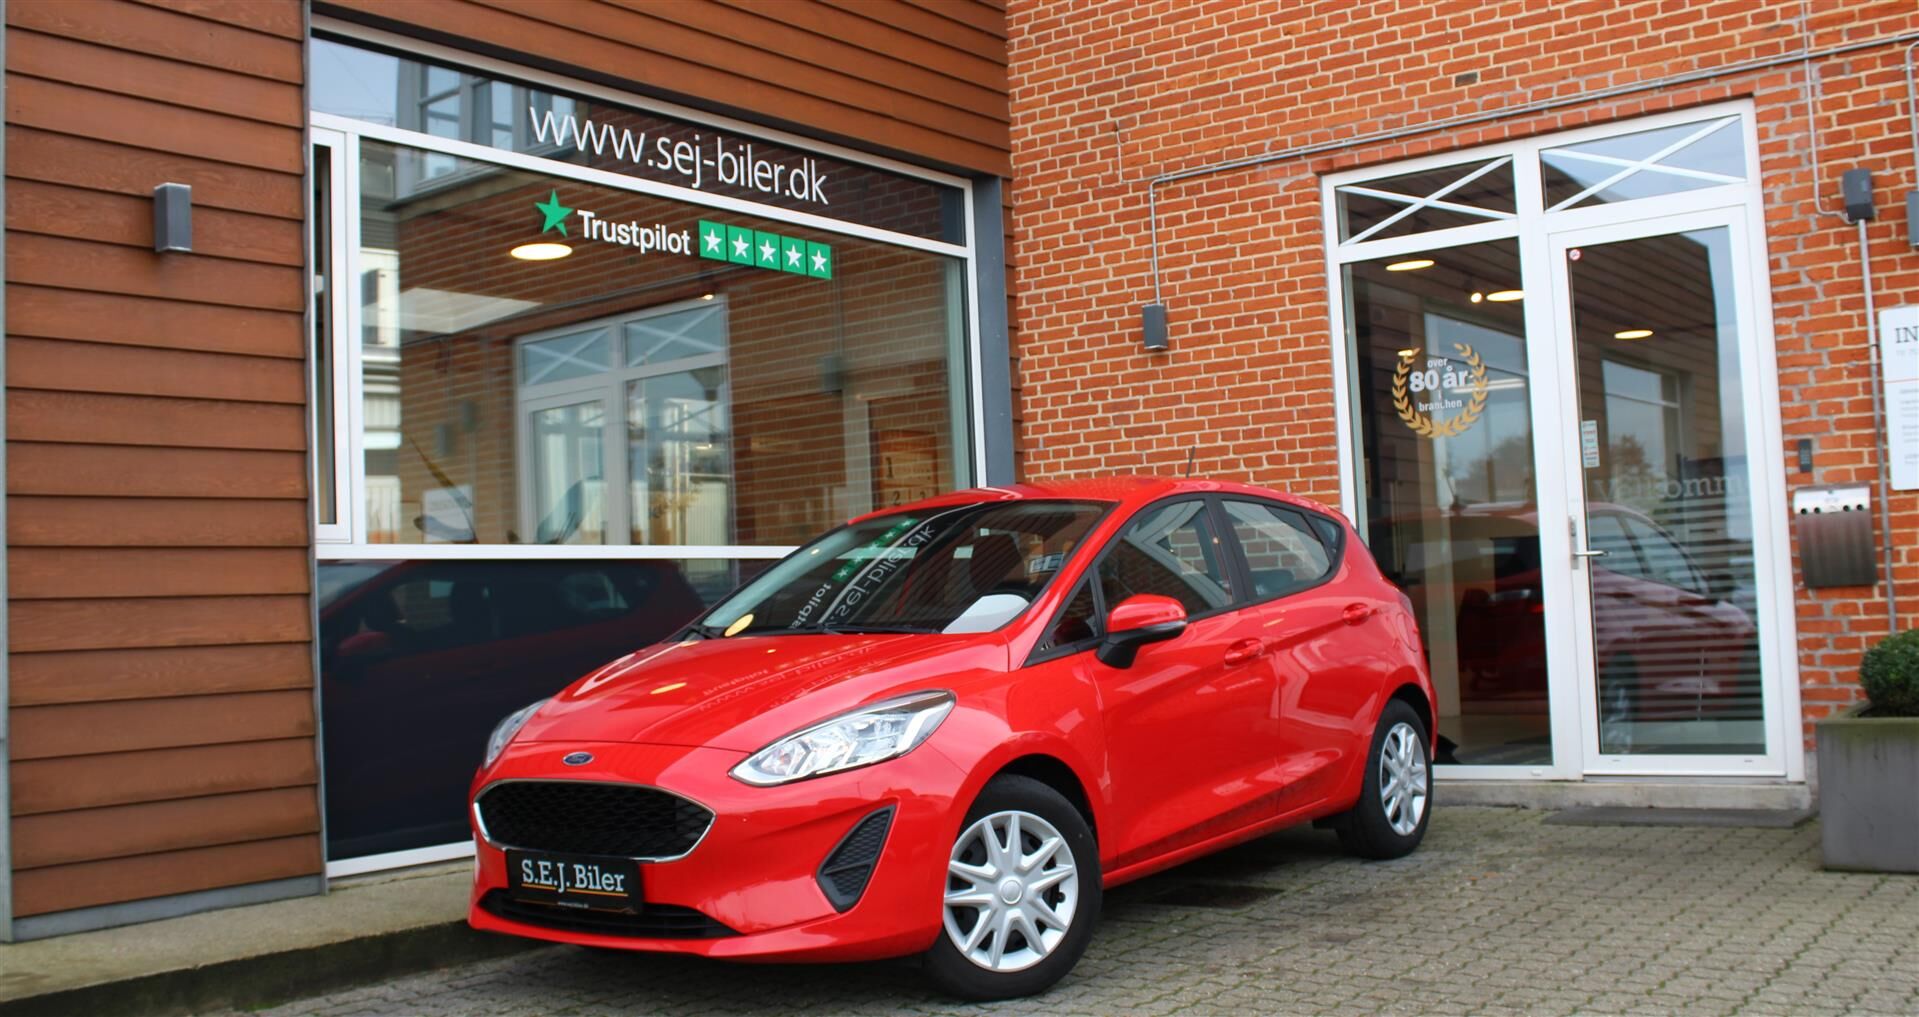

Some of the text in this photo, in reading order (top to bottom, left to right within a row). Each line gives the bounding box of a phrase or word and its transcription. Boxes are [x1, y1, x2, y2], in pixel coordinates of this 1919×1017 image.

[529, 106, 829, 205] www.sej-biler.dk
[577, 209, 691, 255] Trustpilot
[1409, 365, 1468, 392] 80 år
[1427, 358, 1448, 368] over
[521, 859, 625, 893] S.E.J. Biler
